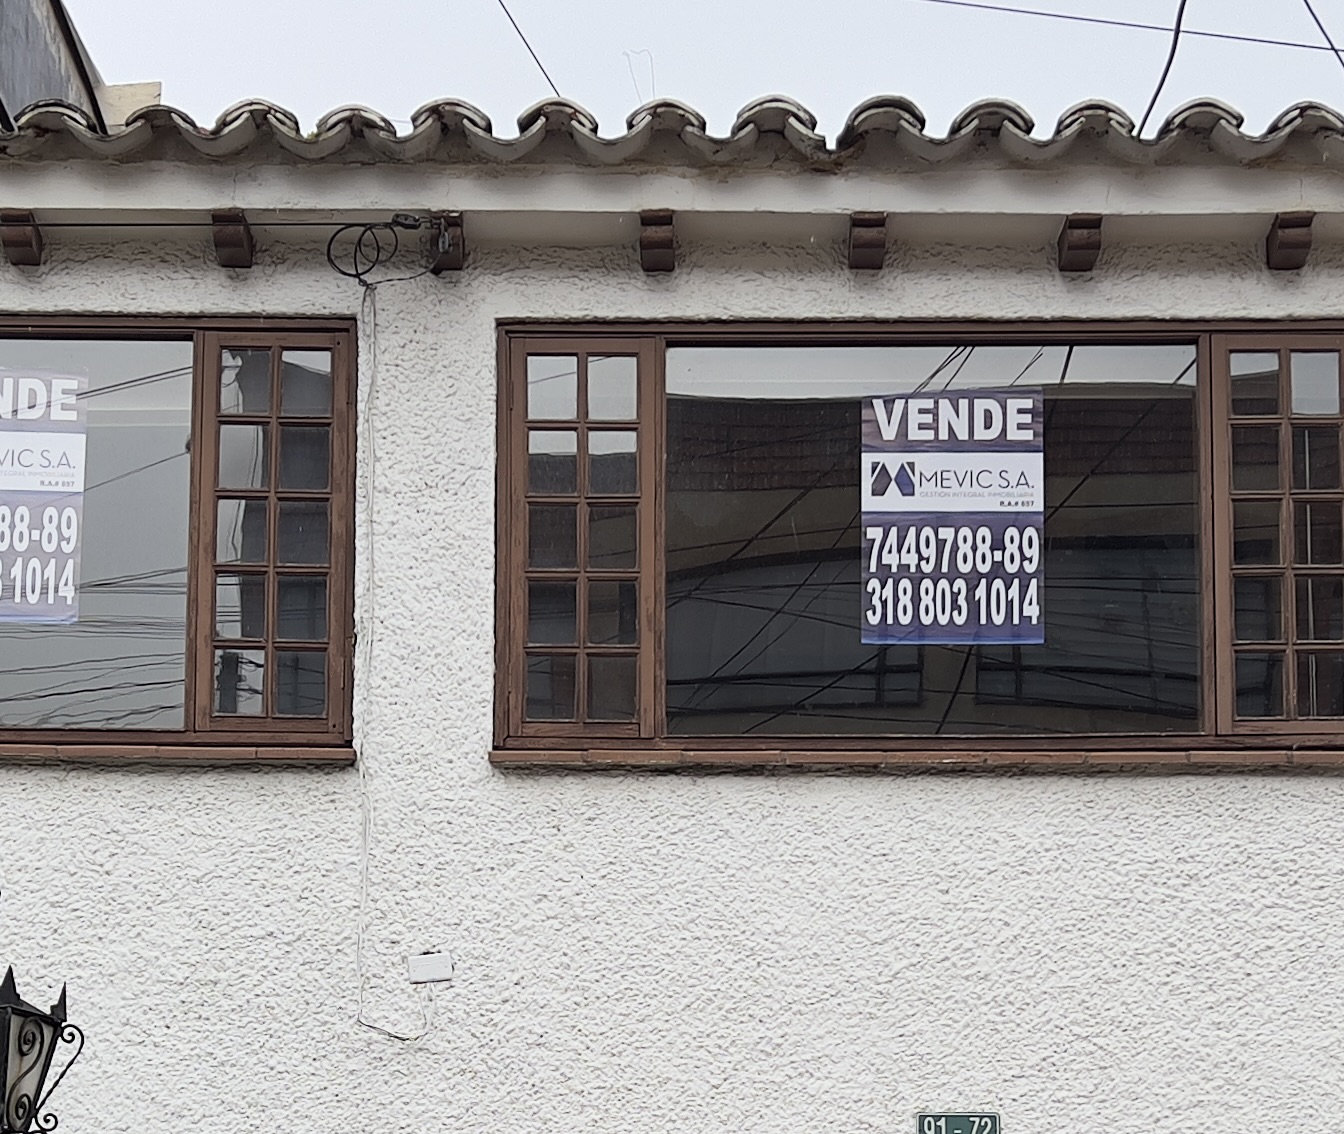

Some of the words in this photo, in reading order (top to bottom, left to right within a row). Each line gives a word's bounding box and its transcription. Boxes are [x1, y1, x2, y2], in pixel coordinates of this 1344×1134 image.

[872, 398, 1034, 441] VENDE
[39, 449, 76, 469] S.A.
[919, 469, 993, 489] MEVIC
[998, 469, 1035, 489] S.A.
[866, 525, 1040, 574] 7449788-89
[10, 556, 75, 604] 1014
[866, 577, 913, 626] 318
[919, 577, 968, 626] 803
[974, 577, 1040, 626] 1014
